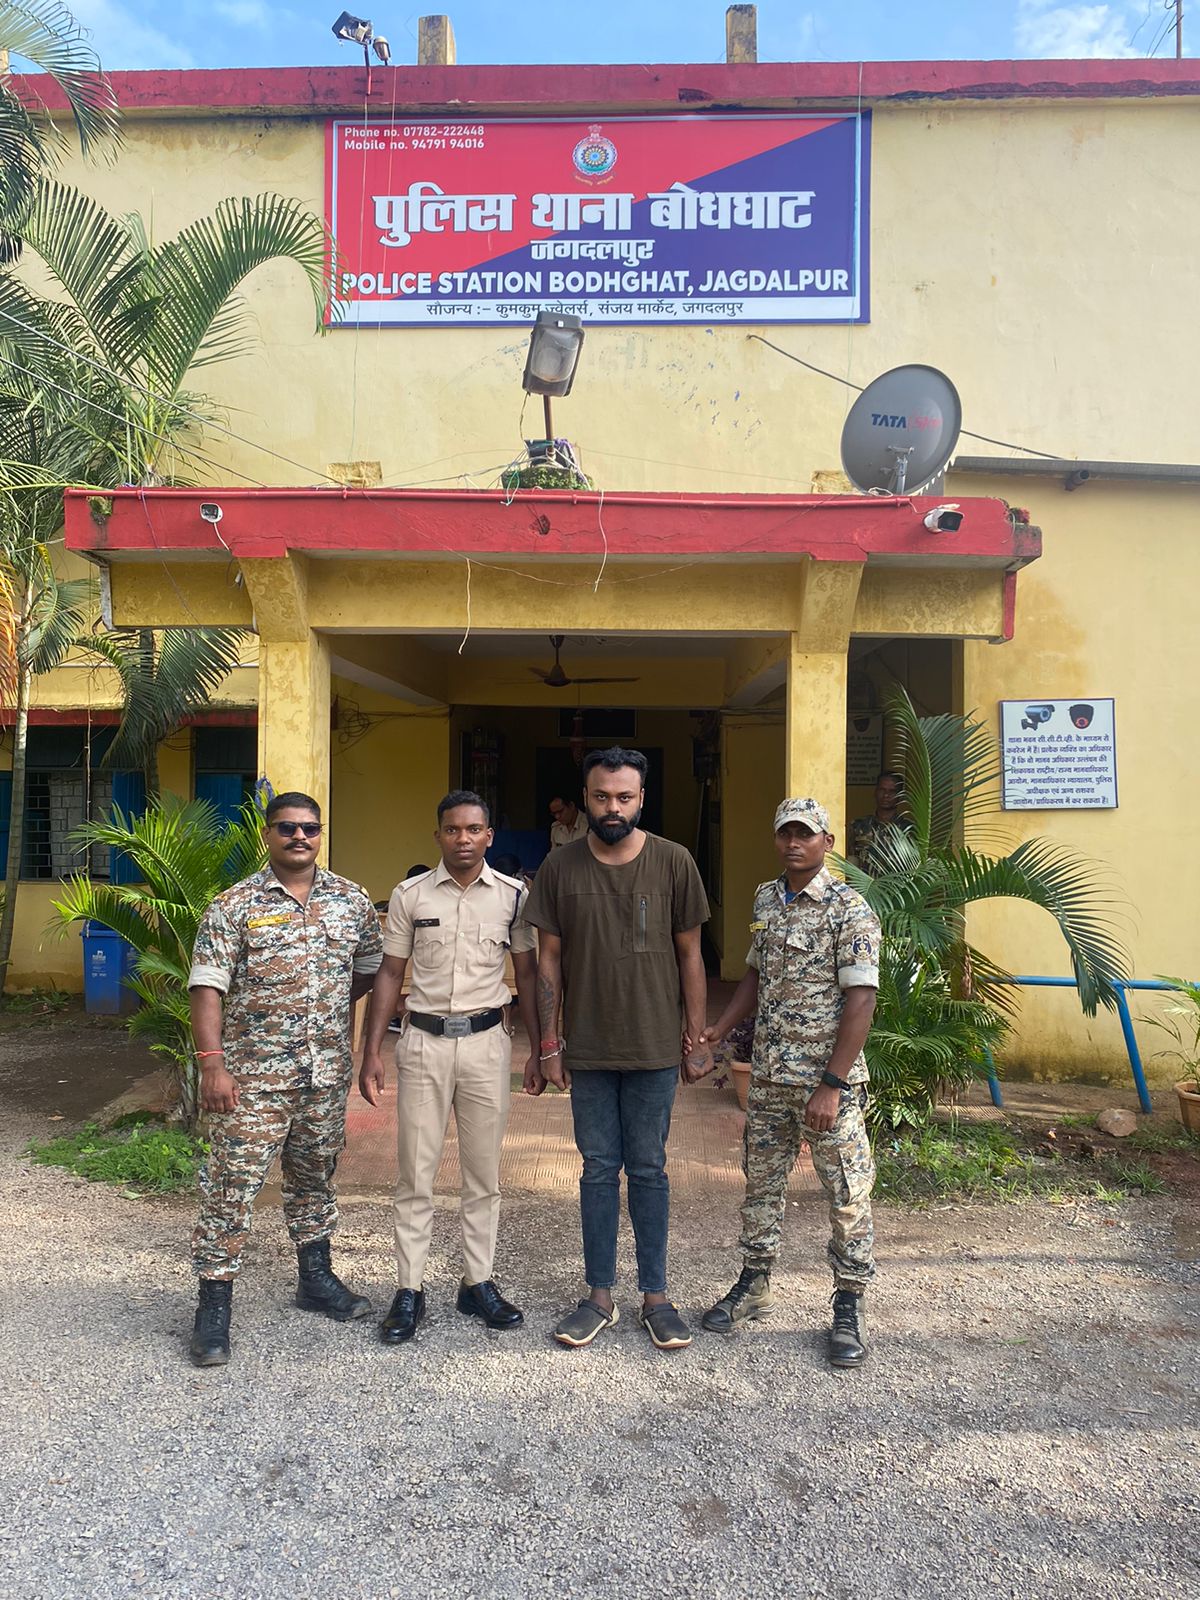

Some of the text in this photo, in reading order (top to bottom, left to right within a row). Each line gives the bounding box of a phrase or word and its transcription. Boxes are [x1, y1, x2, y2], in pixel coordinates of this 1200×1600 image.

[344, 126, 484, 137] Phone no. 07782-222448
[344, 138, 484, 150] Mobile no. 94791 94016
[371, 181, 816, 248] पुलिस थाना बोधघाट
[530, 239, 656, 266] जगदलपुर
[342, 269, 849, 296] POLICE STATION BODHGHAT, JAGDALPUR
[426, 301, 473, 315] सौजन्य
[495, 303, 541, 318] कुमकुम
[598, 300, 633, 315] संजय
[637, 299, 678, 316] मार्केट,
[682, 301, 744, 317] जगदलपुर
[871, 413, 907, 429] TATA
[1095, 774, 1113, 785] पुलिस
